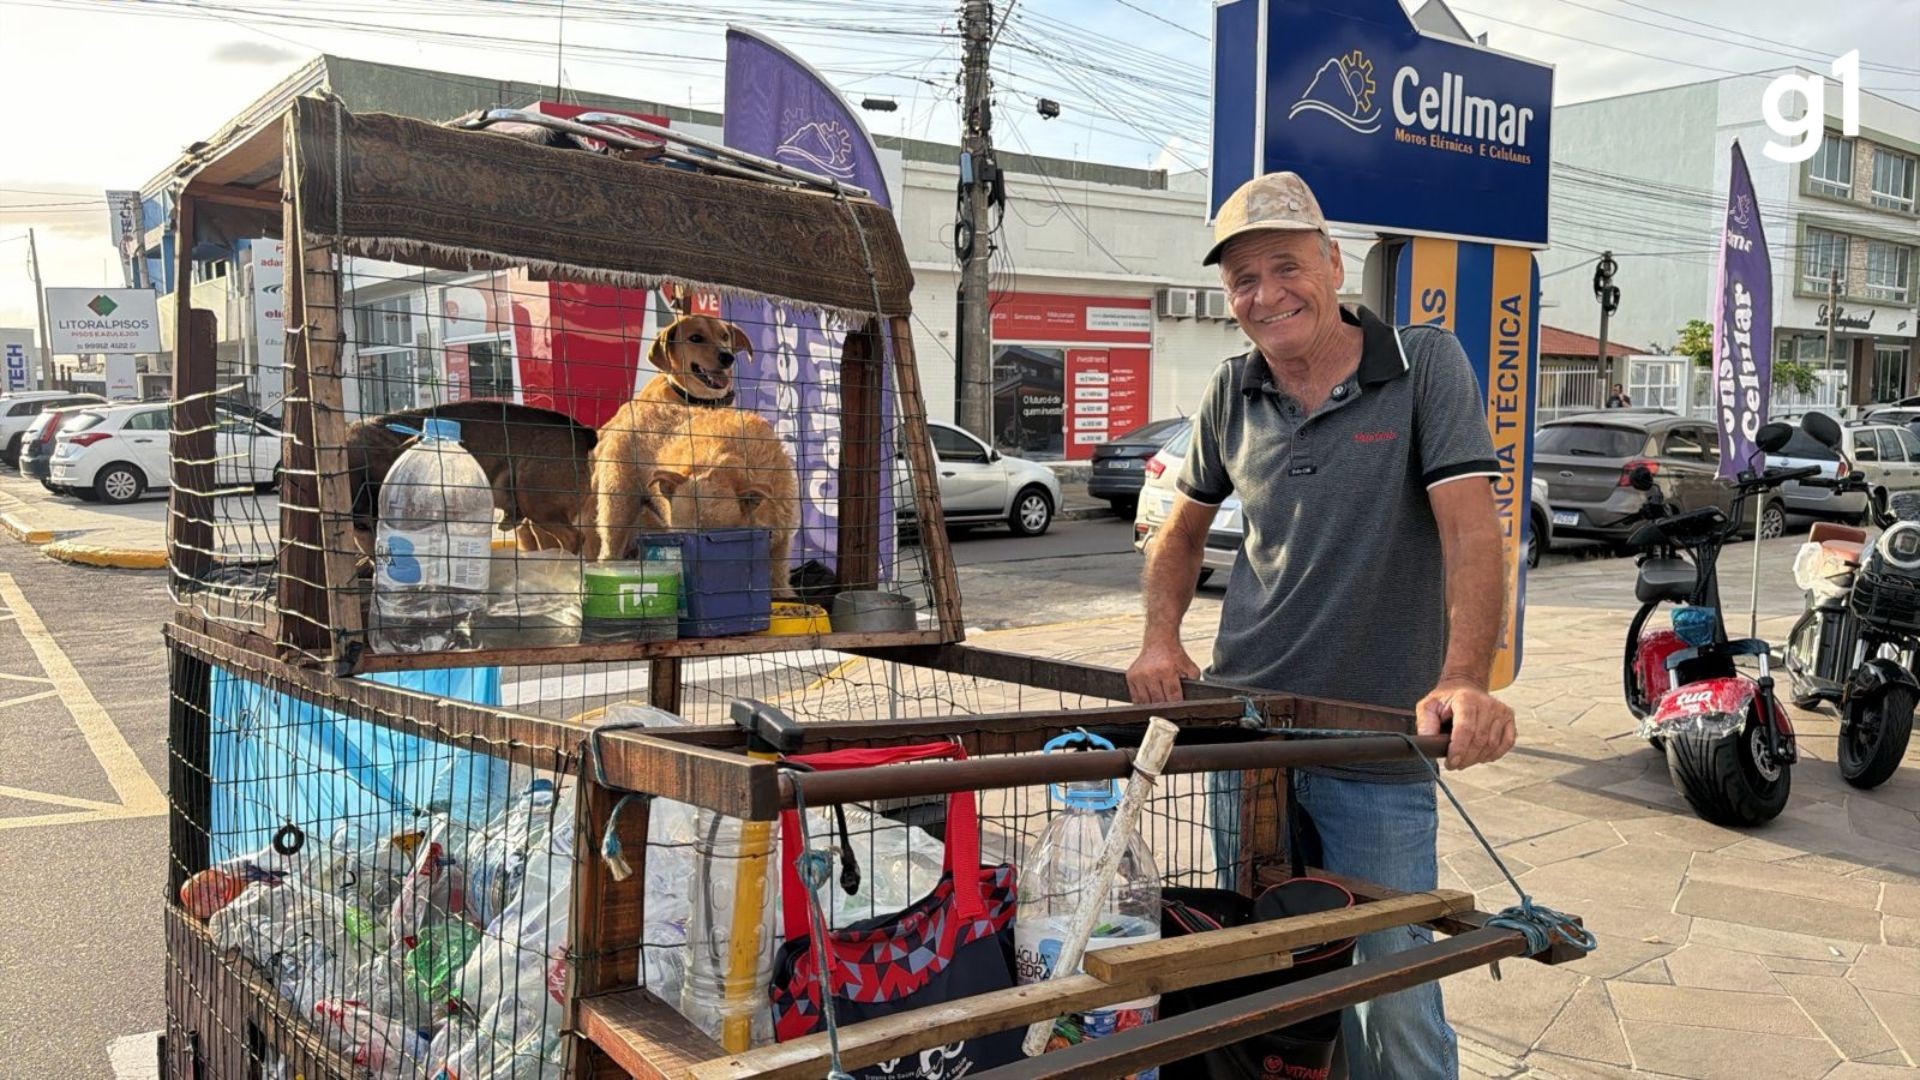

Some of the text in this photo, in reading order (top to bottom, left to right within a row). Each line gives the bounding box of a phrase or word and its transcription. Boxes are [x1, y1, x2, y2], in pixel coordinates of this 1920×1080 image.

[1392, 66, 1534, 147] Cellmar
[1480, 143, 1486, 156] E
[58, 319, 150, 330] LITORALPISOS
[1491, 294, 1521, 434] TÉCNICA
[1733, 282, 1760, 442] Celular
